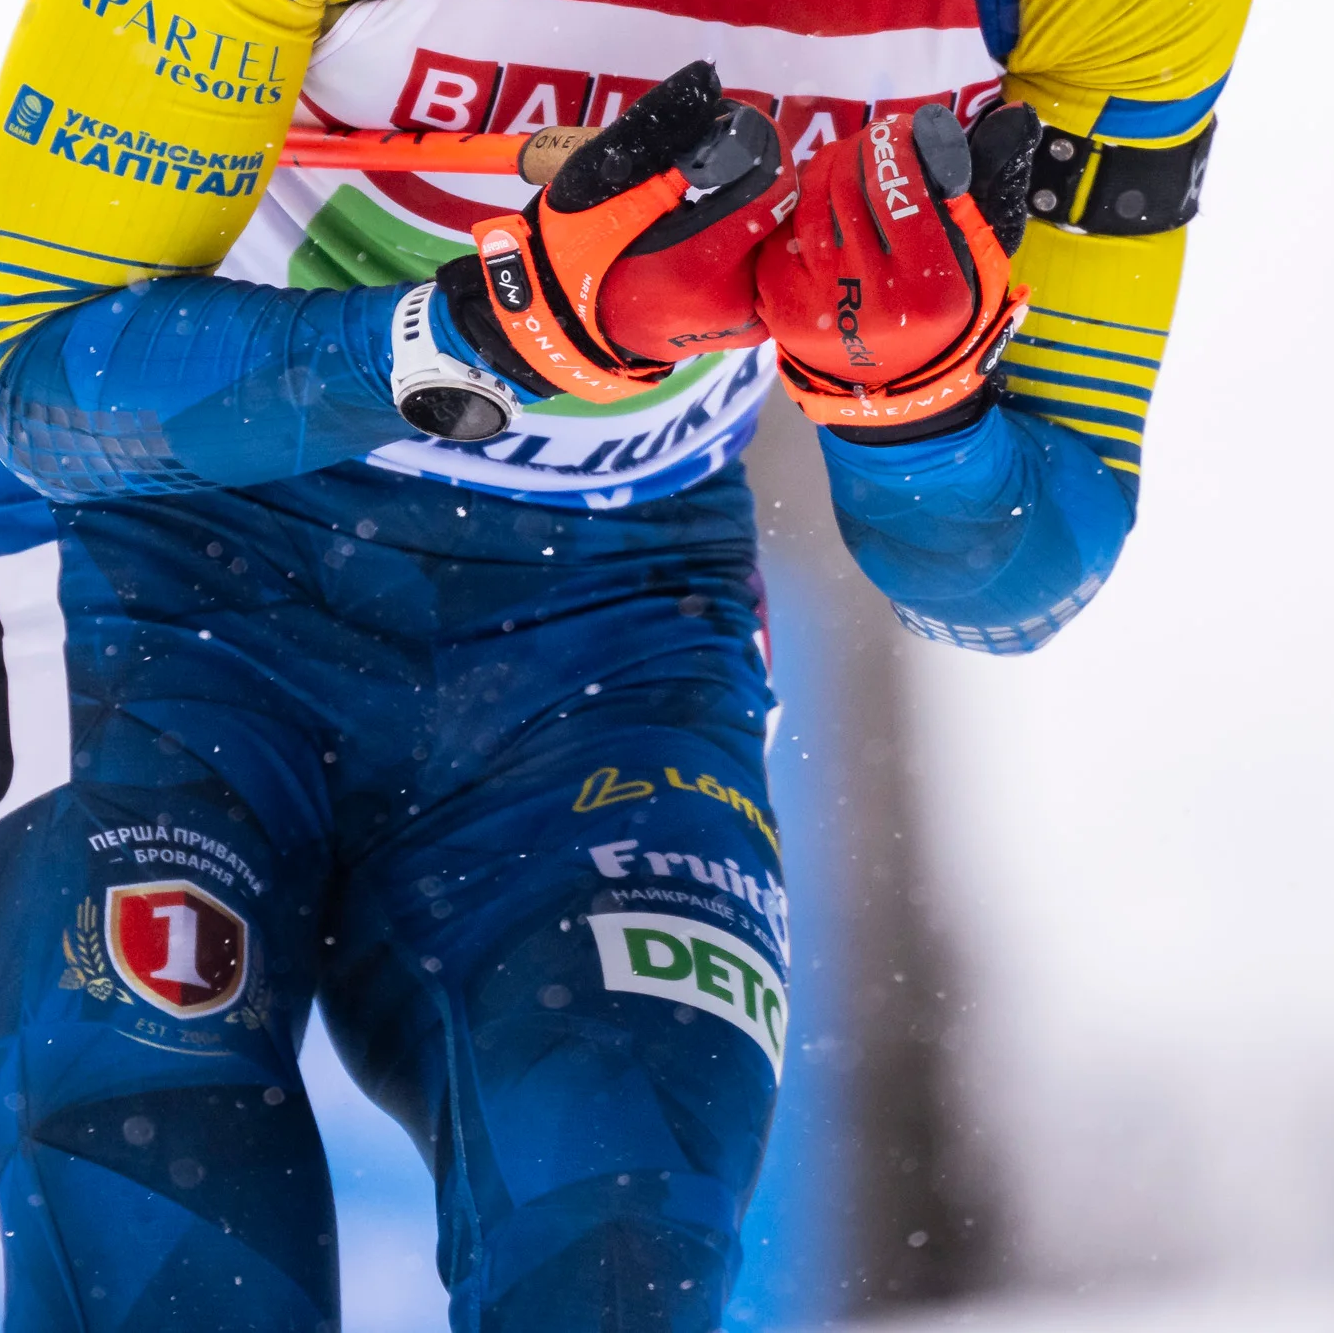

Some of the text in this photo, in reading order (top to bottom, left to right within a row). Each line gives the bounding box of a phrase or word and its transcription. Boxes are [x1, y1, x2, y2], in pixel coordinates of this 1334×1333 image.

[154, 55, 283, 105] resorts
[49, 128, 260, 198] КАПІТАЛ
[64, 107, 265, 171] УКРАЇНСЬКИЙ
[88, 825, 266, 897] ПЕРША ПРИВАТНА
[134, 849, 235, 888] БРОВАРНЯ
[150, 904, 212, 990] 1
